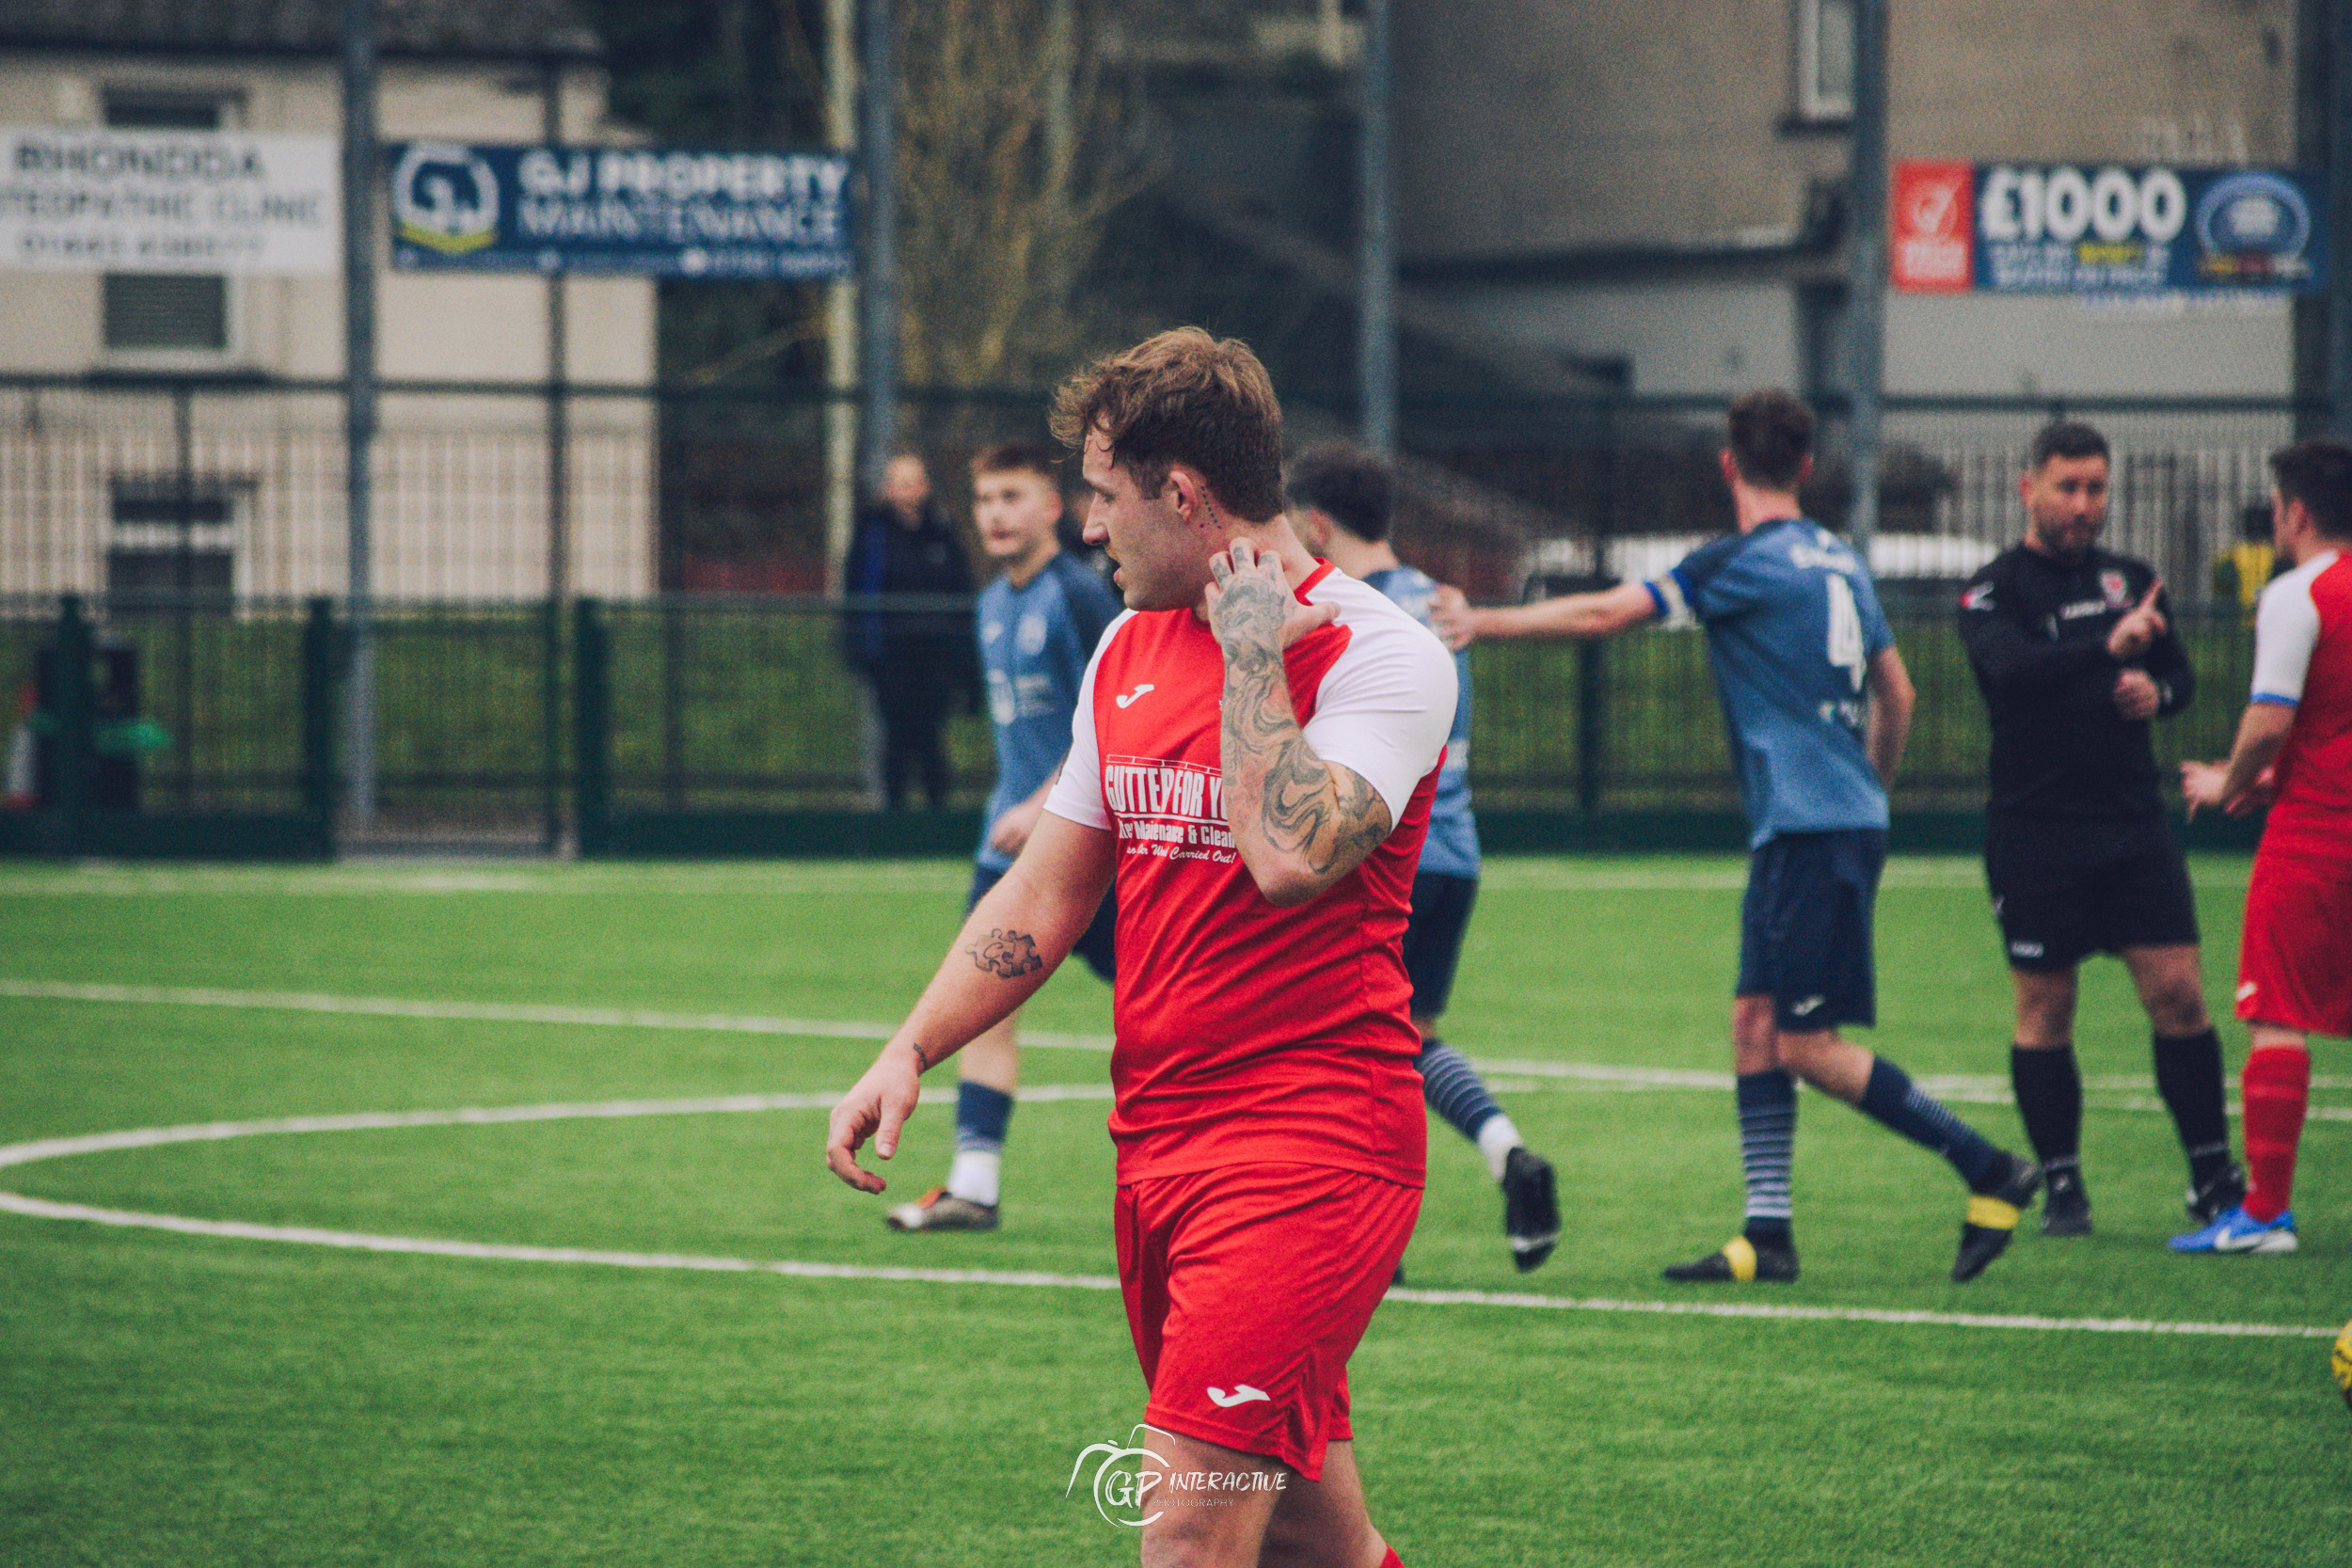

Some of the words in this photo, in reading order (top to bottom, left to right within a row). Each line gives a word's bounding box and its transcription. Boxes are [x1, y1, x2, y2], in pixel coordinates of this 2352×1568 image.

[516, 149, 593, 197] GJ
[596, 150, 850, 200] PROPERTY
[517, 197, 846, 244] MAINTENANCE
[1982, 166, 2187, 243] £1000
[1826, 572, 1867, 694] 4
[1172, 769, 1205, 817] FOR
[1169, 846, 1211, 861] Carried
[1187, 825, 1198, 845] &
[1200, 826, 1236, 848] Clean
